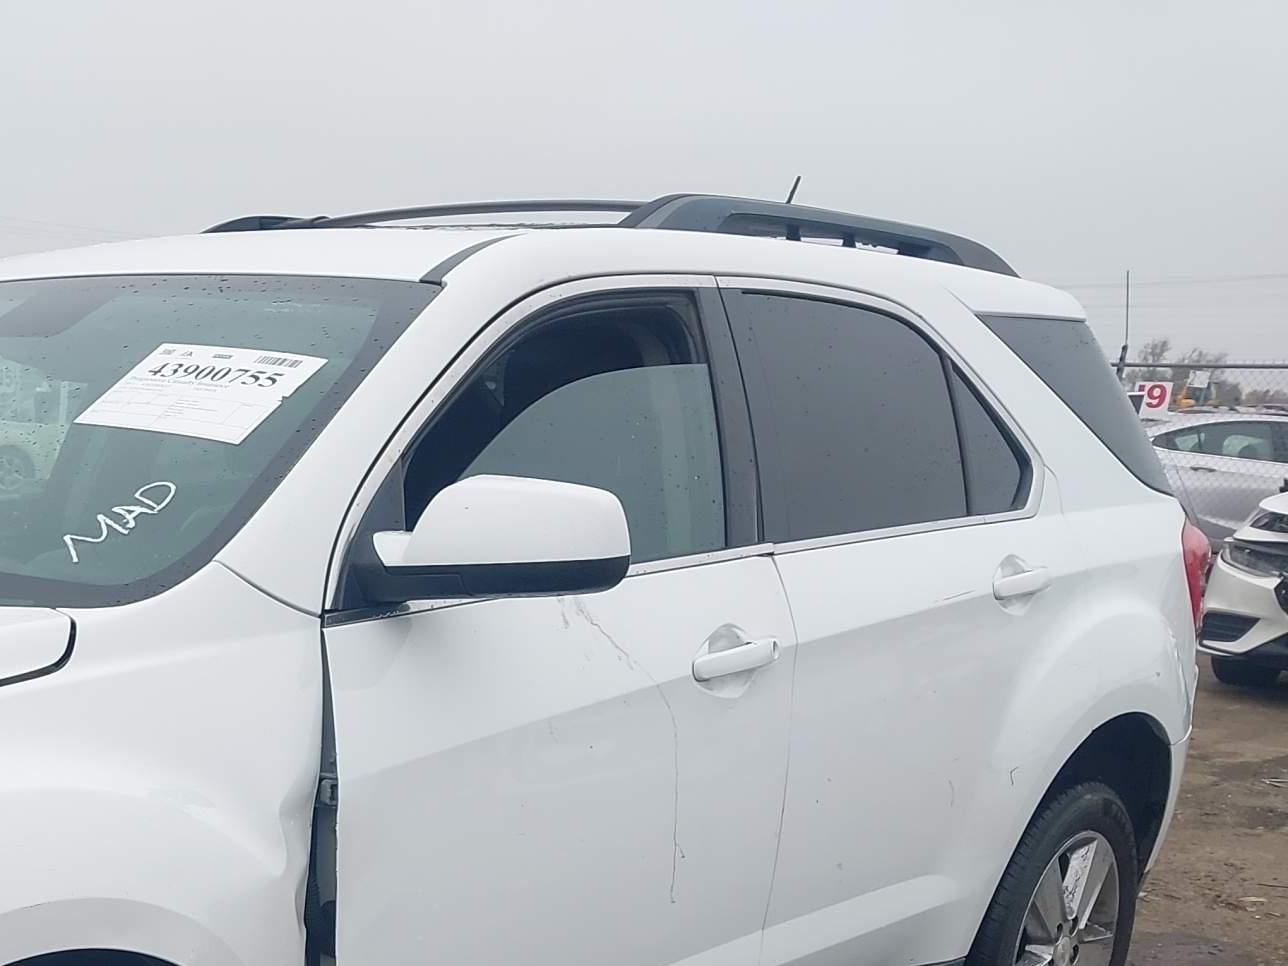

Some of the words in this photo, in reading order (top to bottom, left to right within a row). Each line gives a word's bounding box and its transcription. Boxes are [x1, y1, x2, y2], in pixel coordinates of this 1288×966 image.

[148, 362, 286, 388] 43900755
[1138, 383, 1168, 409] 9
[63, 481, 177, 563] MAD
